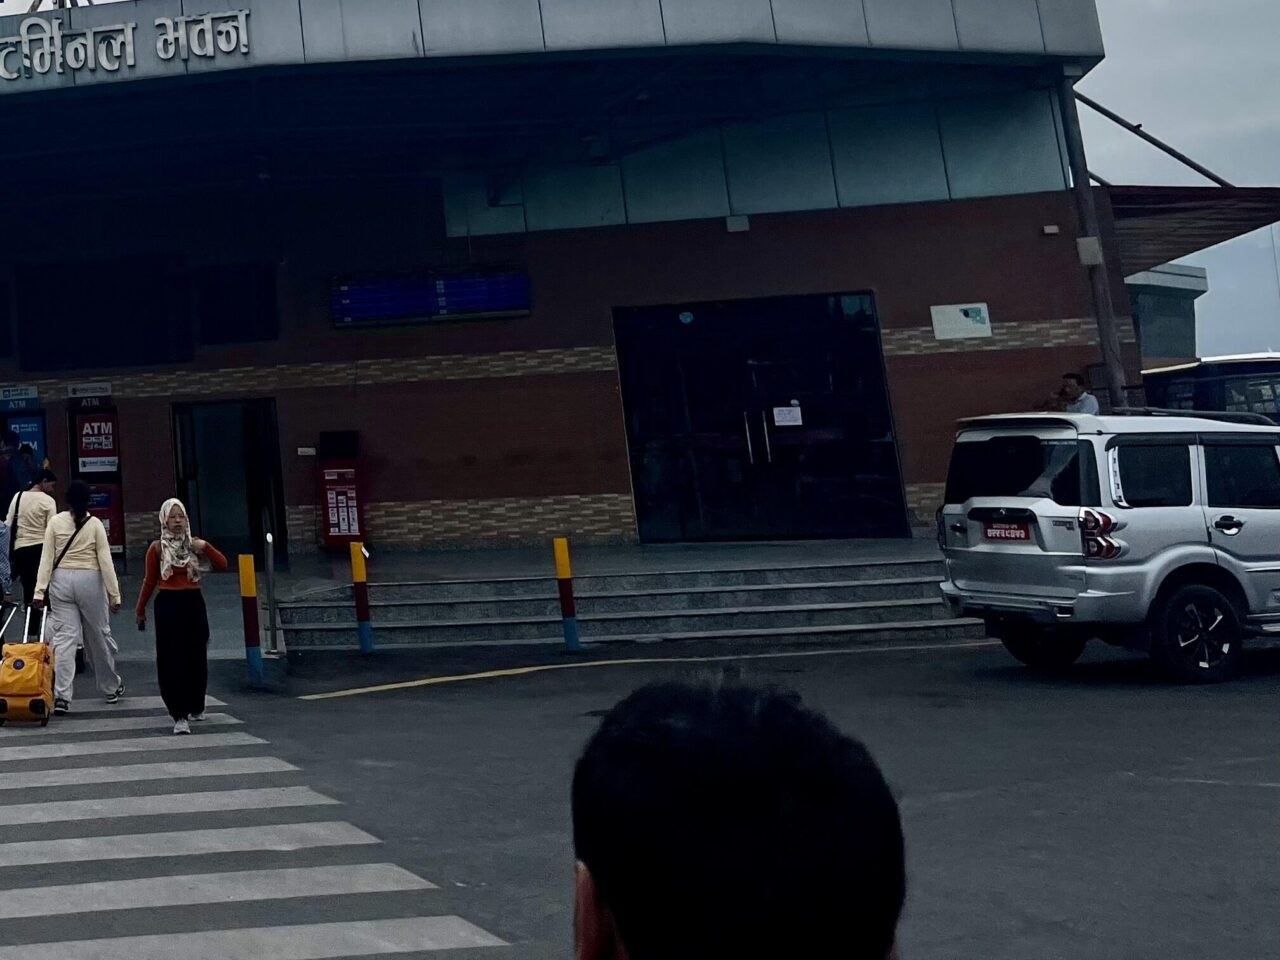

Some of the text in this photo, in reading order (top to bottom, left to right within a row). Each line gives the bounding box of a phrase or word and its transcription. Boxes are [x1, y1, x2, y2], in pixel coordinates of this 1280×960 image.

[154, 8, 251, 60] भवन
[8, 400, 26, 409] ATM
[81, 398, 100, 408] ATM
[82, 422, 113, 435] ATM
